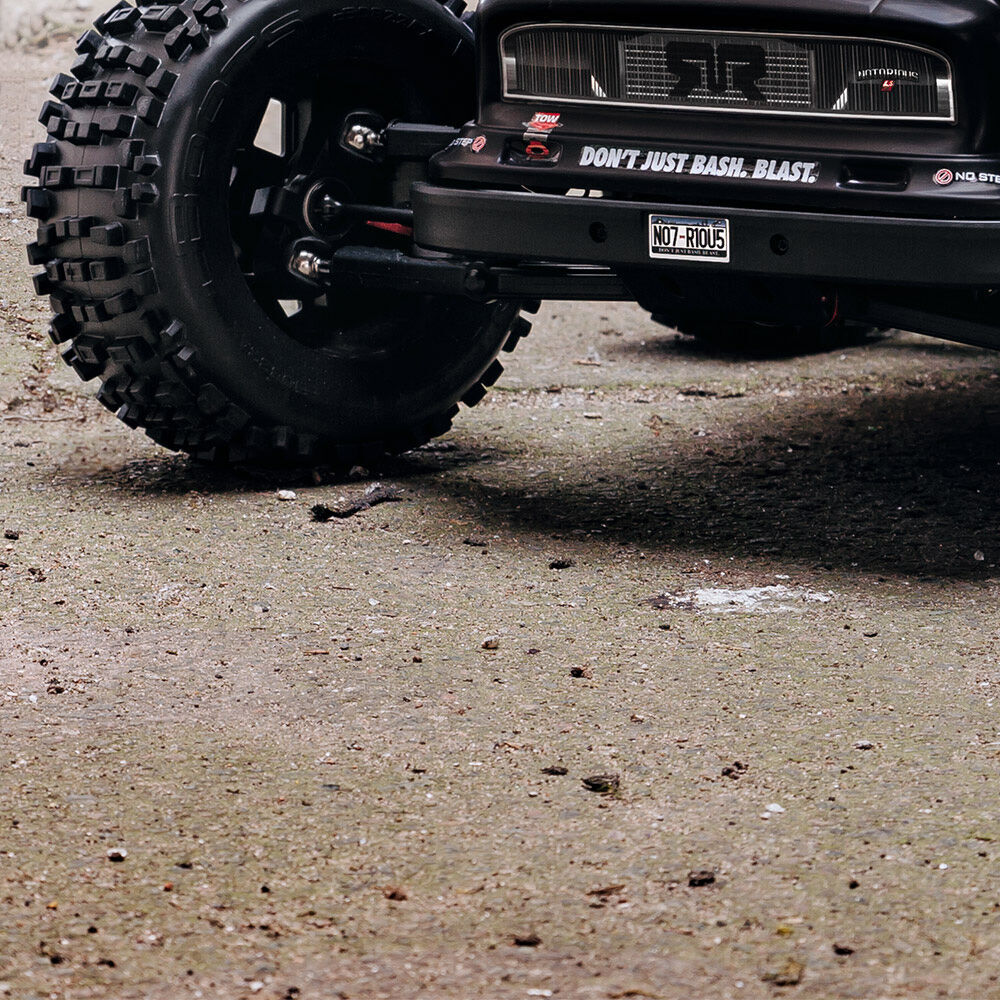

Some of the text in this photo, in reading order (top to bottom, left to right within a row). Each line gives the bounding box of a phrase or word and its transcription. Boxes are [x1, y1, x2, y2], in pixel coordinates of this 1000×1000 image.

[534, 113, 561, 124] TOW
[579, 147, 817, 184] DON'T JUST BASH. BLAST.
[955, 171, 977, 182] NO
